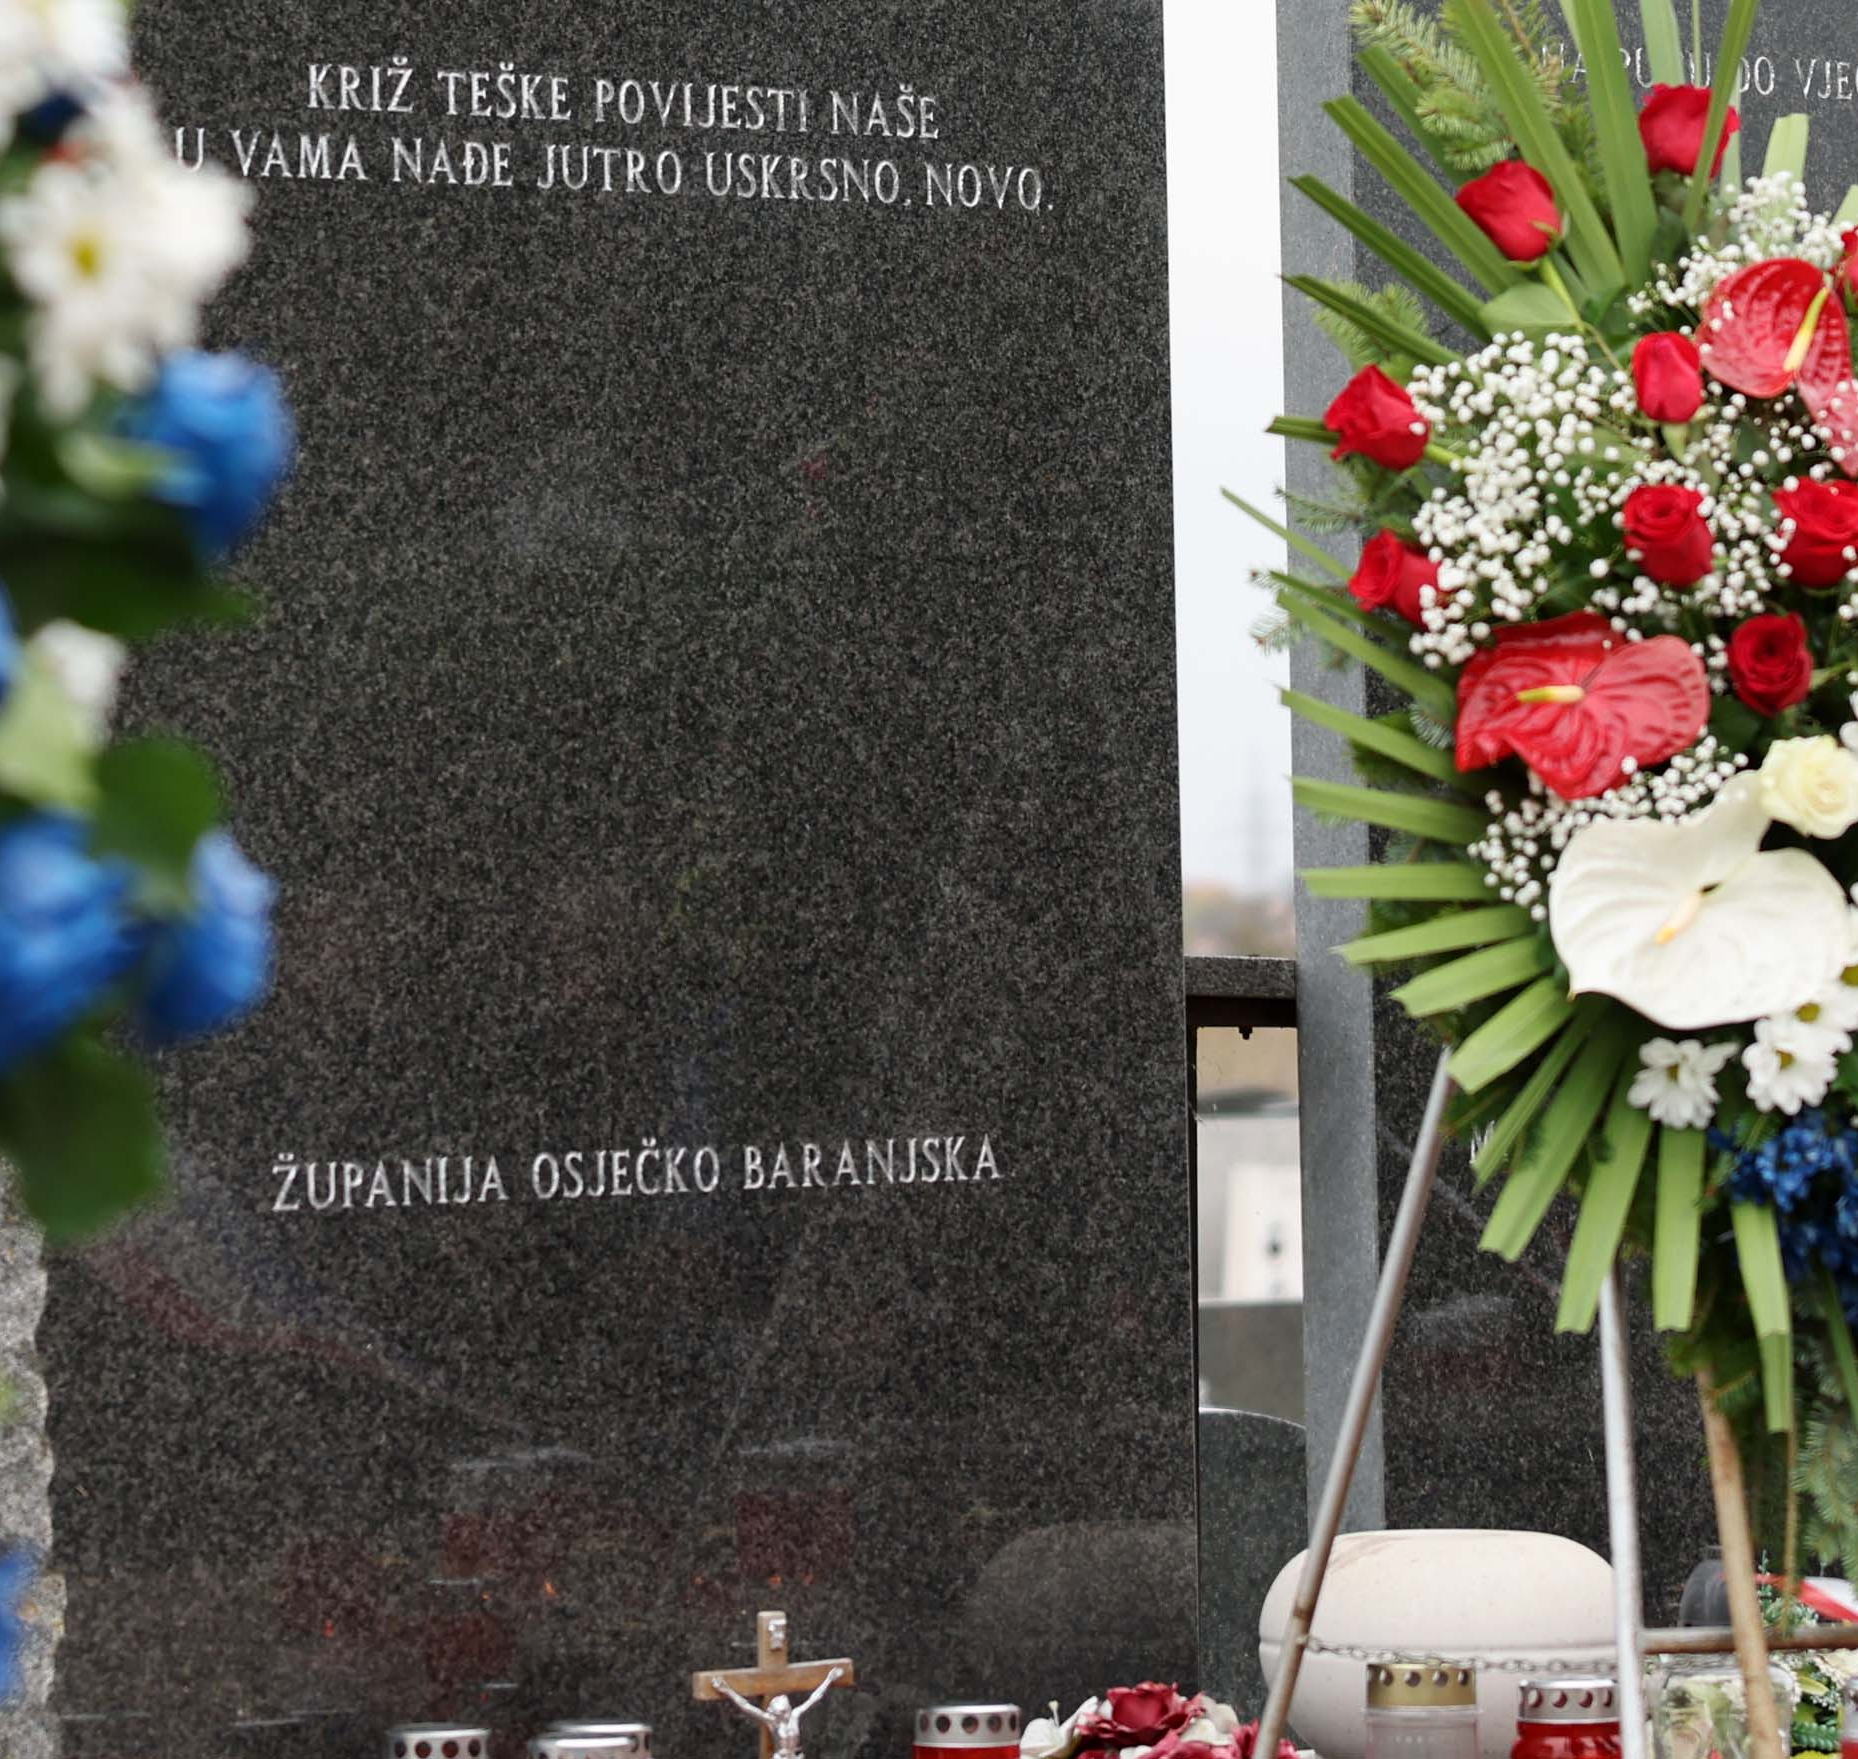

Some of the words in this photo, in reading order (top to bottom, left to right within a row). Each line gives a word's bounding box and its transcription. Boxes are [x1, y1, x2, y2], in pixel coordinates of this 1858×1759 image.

[306, 54, 412, 114] KRIŽ
[436, 62, 572, 124] TEŠKE
[593, 78, 809, 134] POVIJESTI
[829, 83, 941, 142] NAŠE
[174, 126, 207, 176] U
[229, 130, 369, 184] VAMA
[392, 137, 515, 189] NAĐE
[536, 144, 683, 195] JUTRO
[924, 162, 1056, 213] NOVO.
[271, 1148, 510, 1213] ŽUPANIJA
[530, 1136, 721, 1200] OSJEČKO
[741, 1133, 1004, 1191] BARANJSKA
